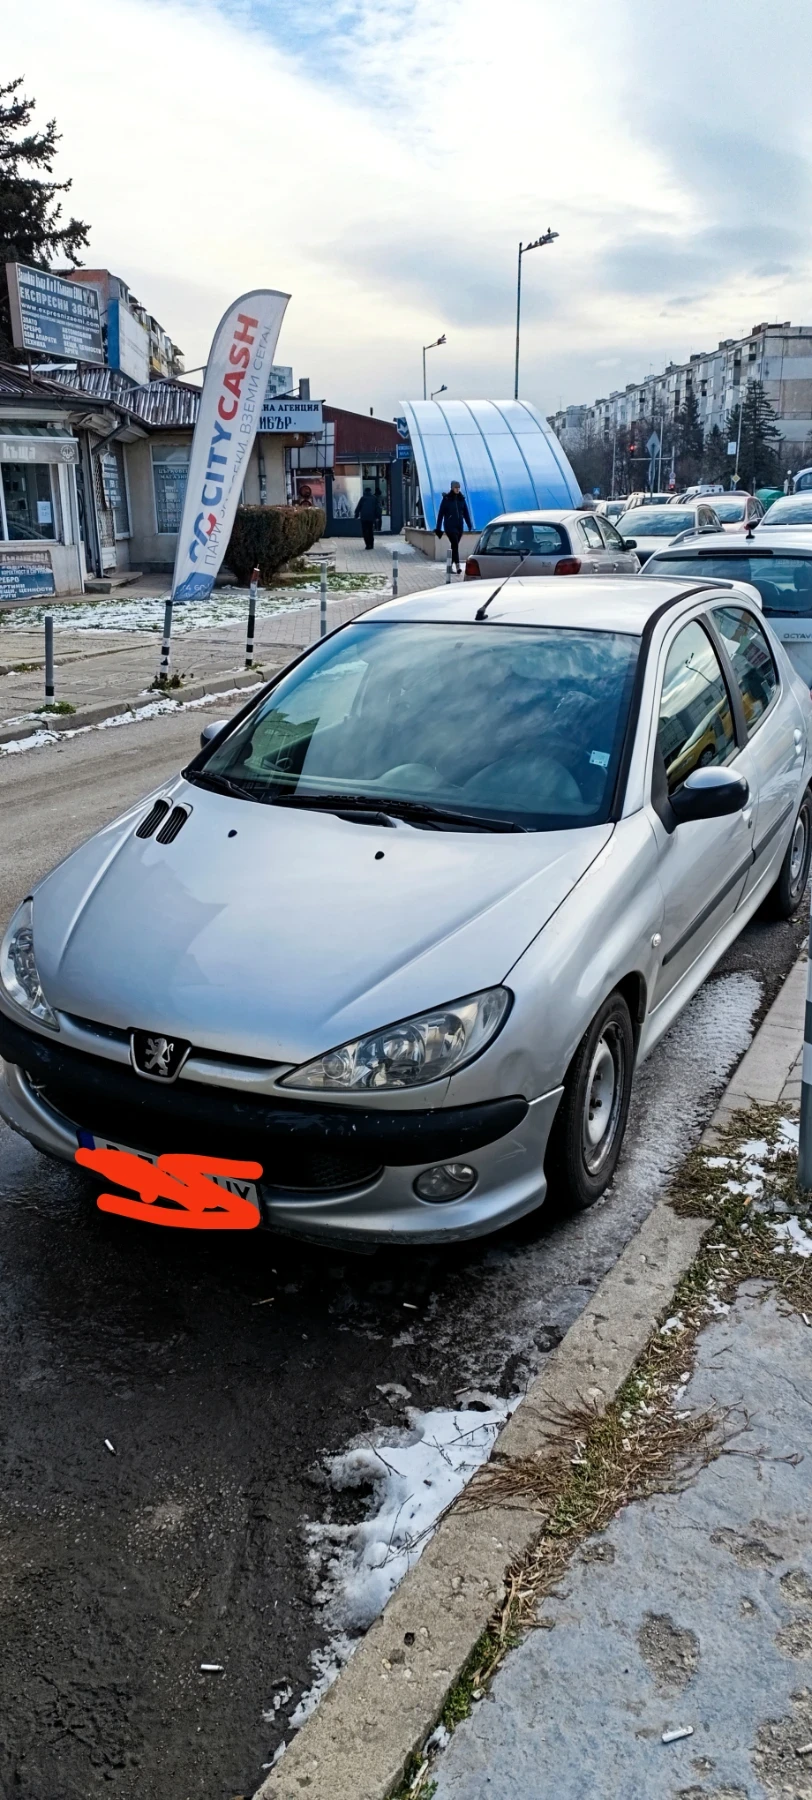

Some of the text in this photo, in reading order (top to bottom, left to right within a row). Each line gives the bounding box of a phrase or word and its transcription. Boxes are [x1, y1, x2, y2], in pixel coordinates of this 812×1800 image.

[19, 286, 98, 320] ЕКСПРЕСНИ ЗАЕМИ
[239, 374, 259, 434] ВЗЕМИ
[278, 404, 319, 412] АГЕНЦИЯ
